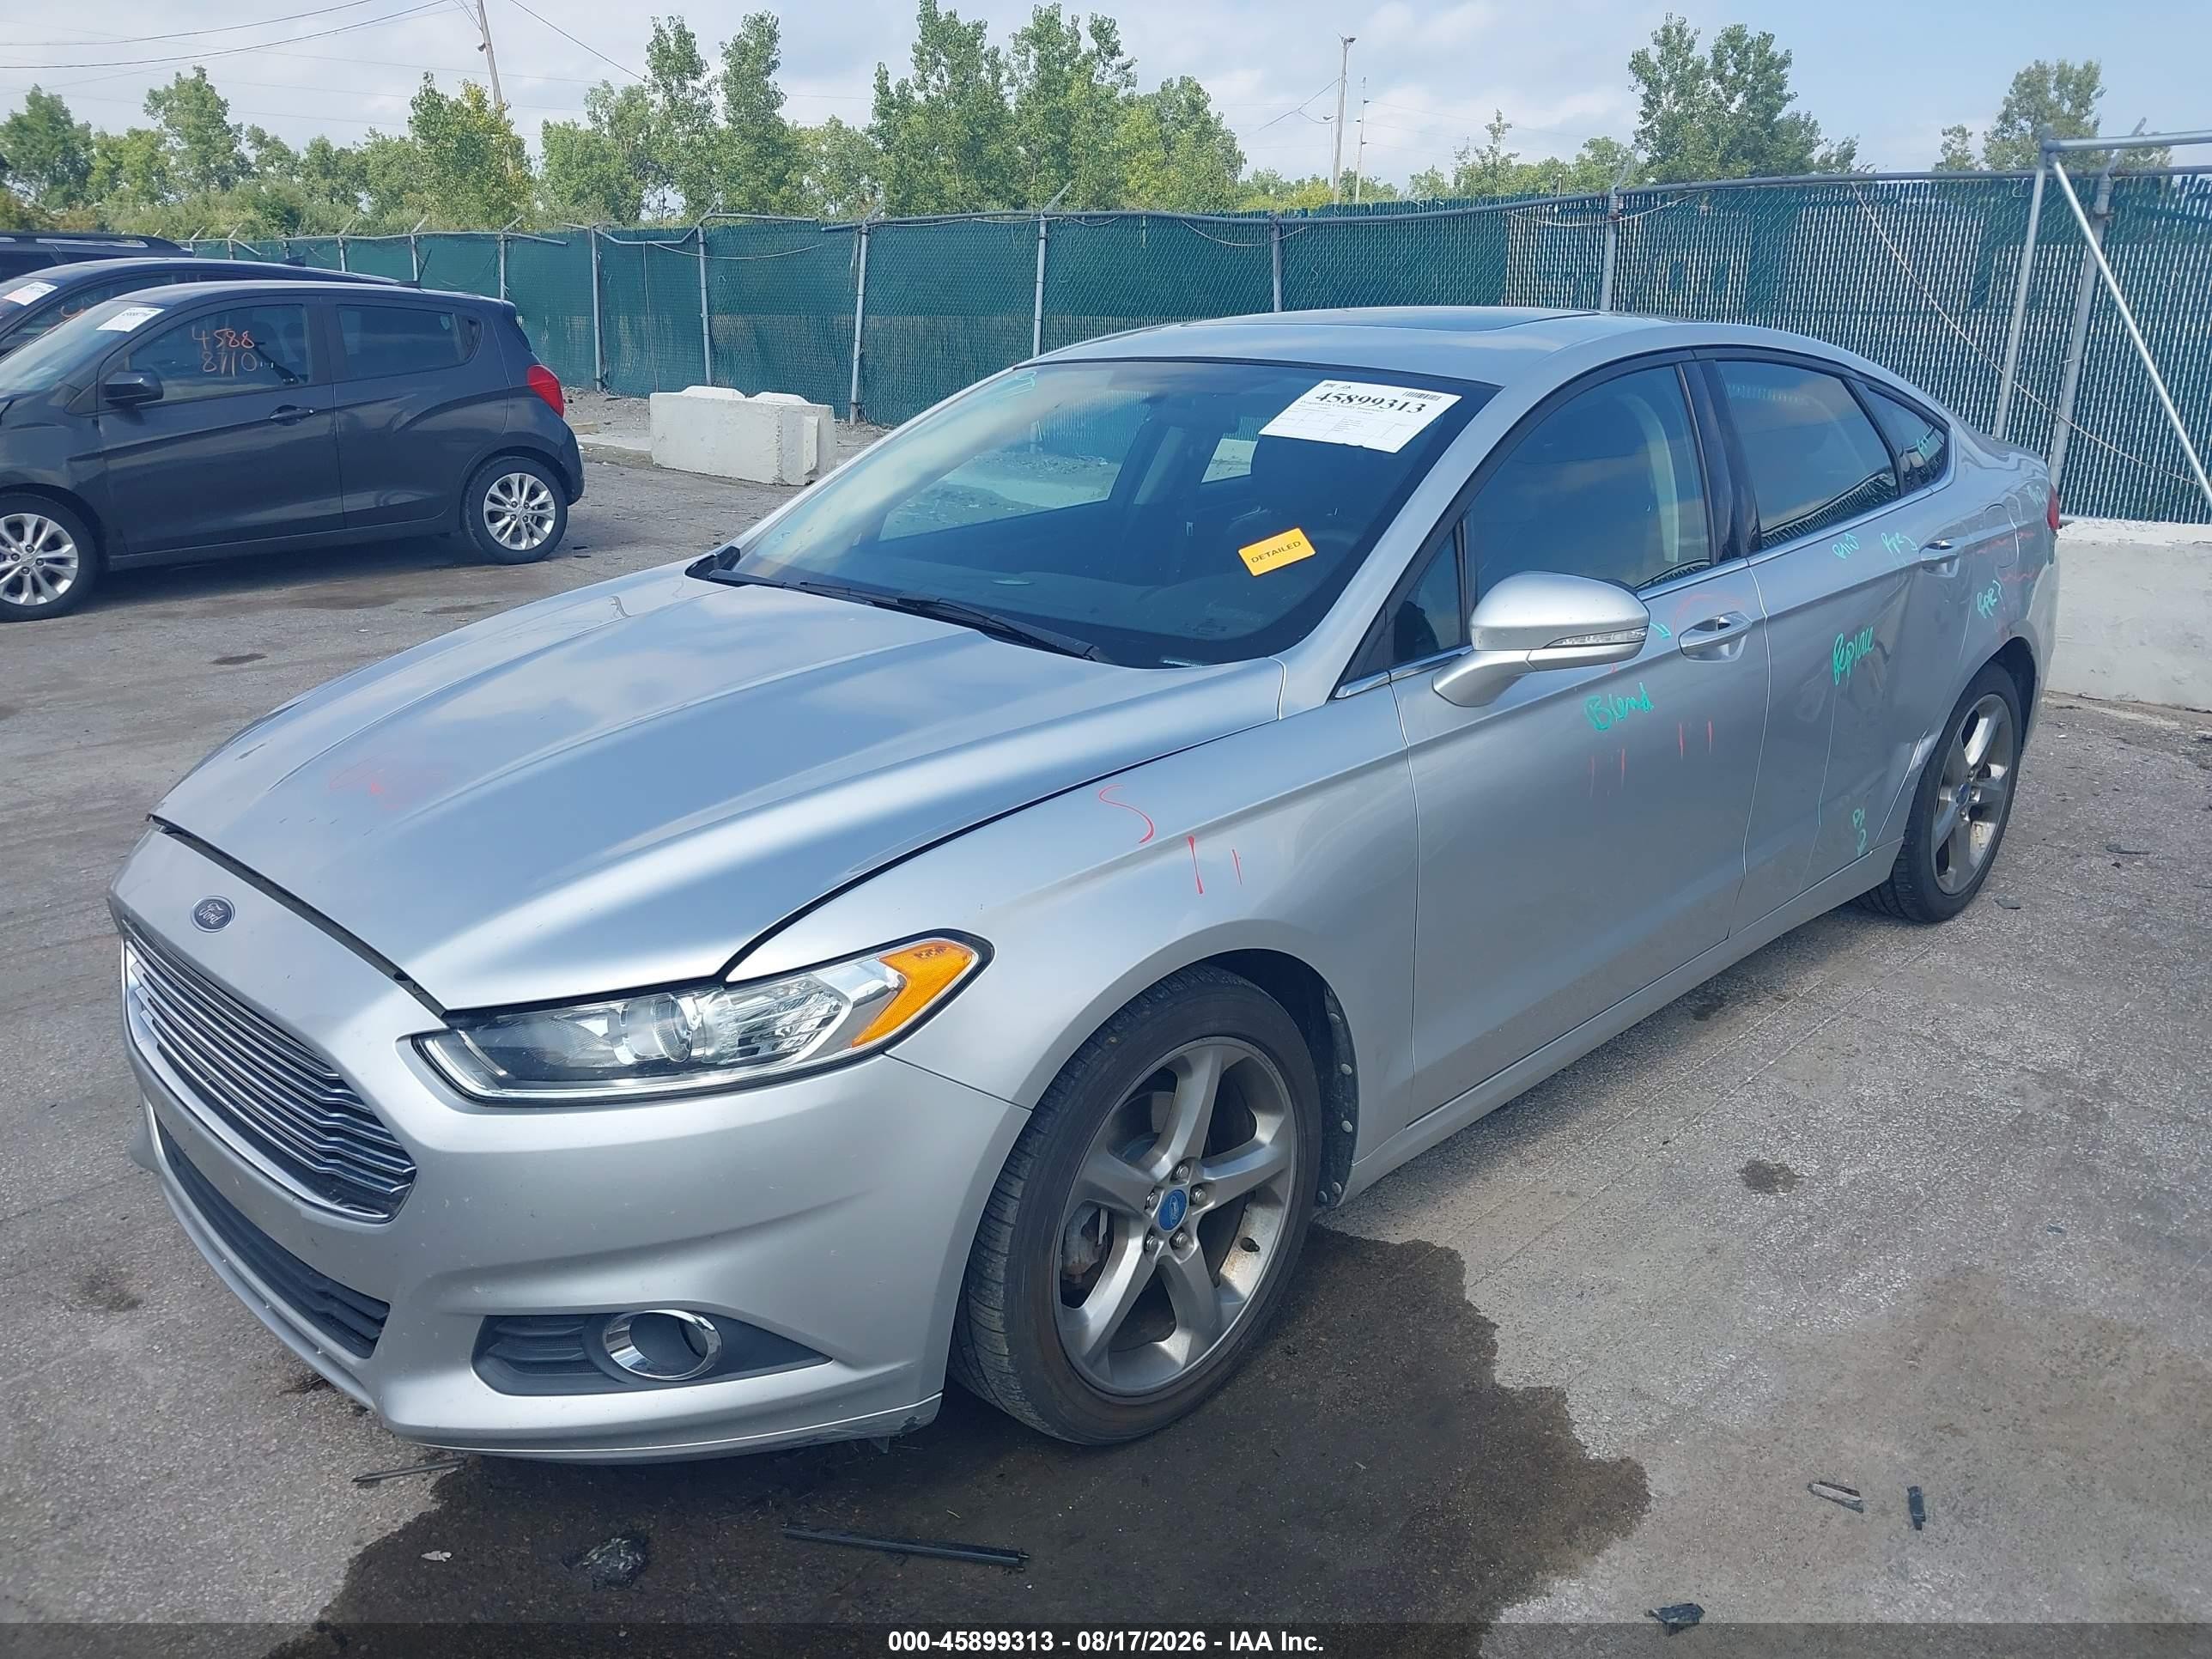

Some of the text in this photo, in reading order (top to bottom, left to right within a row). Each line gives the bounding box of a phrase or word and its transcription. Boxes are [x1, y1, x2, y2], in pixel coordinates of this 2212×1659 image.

[191, 326, 255, 349] 4588
[201, 350, 258, 378] 8710
[1315, 392, 1426, 414] 45899313
[1250, 541, 1302, 563] DETAILED
[1584, 682, 1655, 732] Blend
